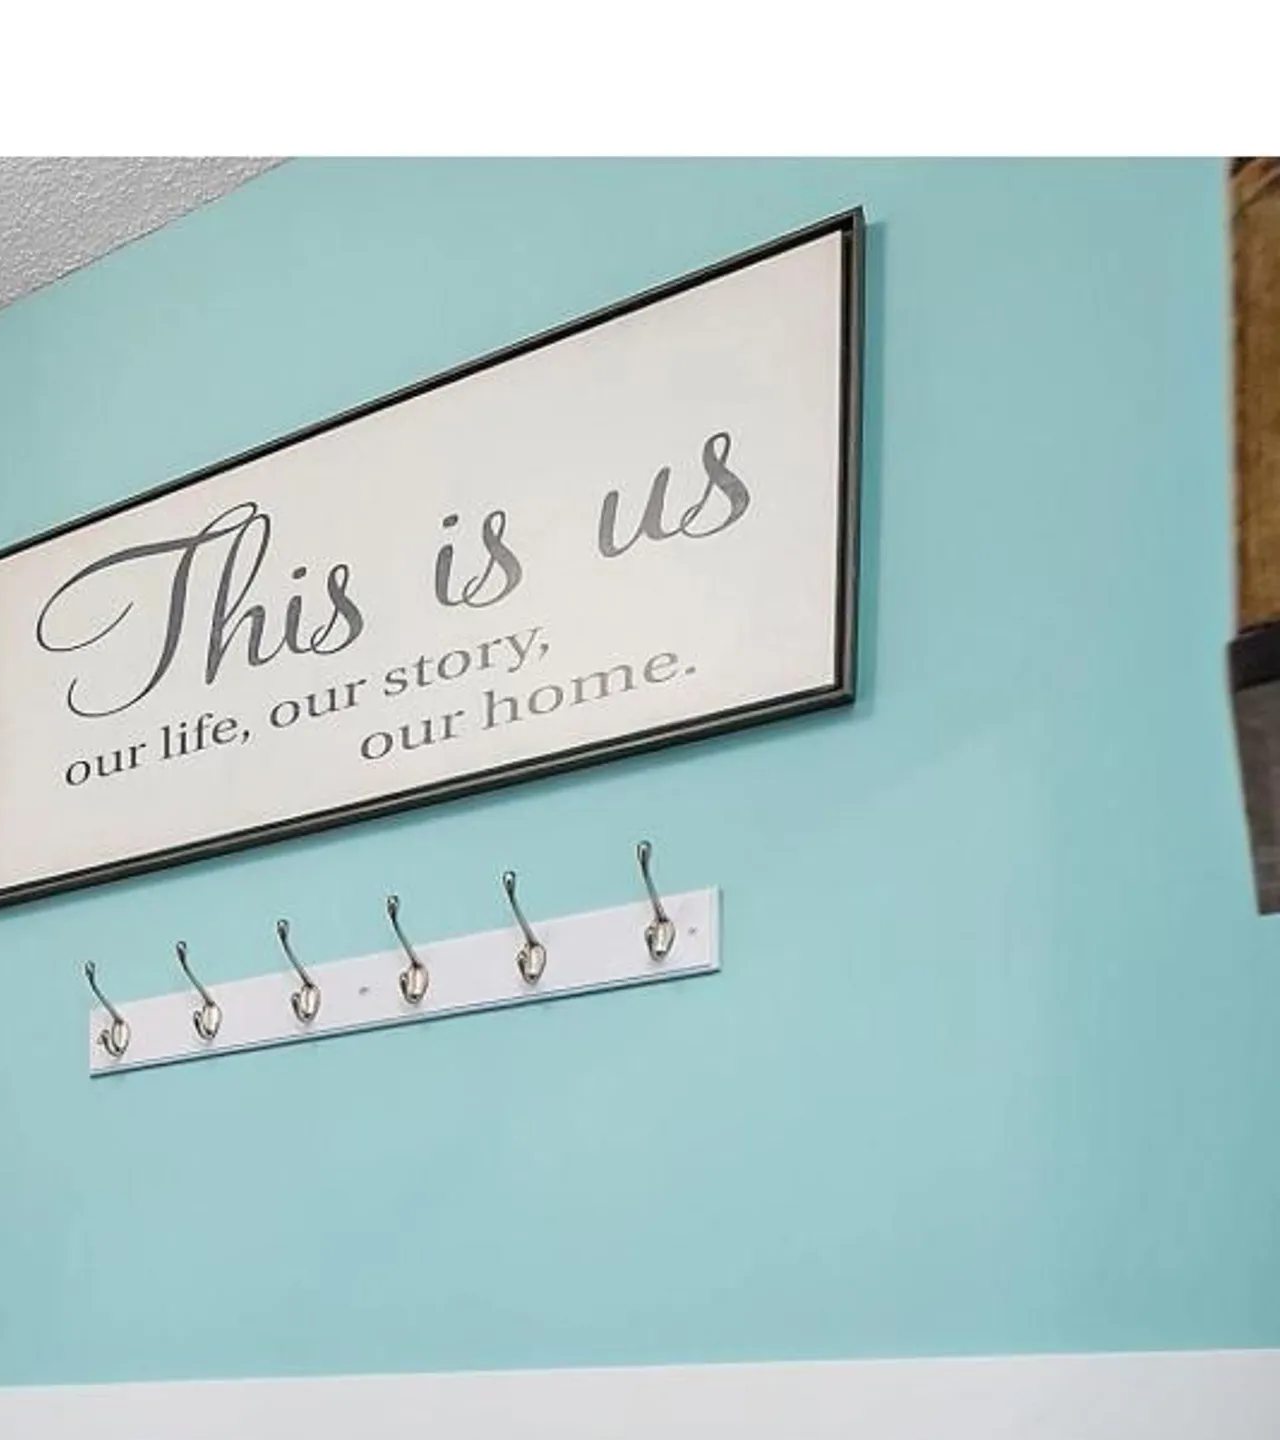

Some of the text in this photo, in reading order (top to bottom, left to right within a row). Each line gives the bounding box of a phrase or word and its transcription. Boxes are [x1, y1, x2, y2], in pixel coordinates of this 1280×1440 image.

[36, 431, 753, 718] This is us
[65, 626, 551, 787] our life, our story,
[360, 650, 697, 761] our home.
